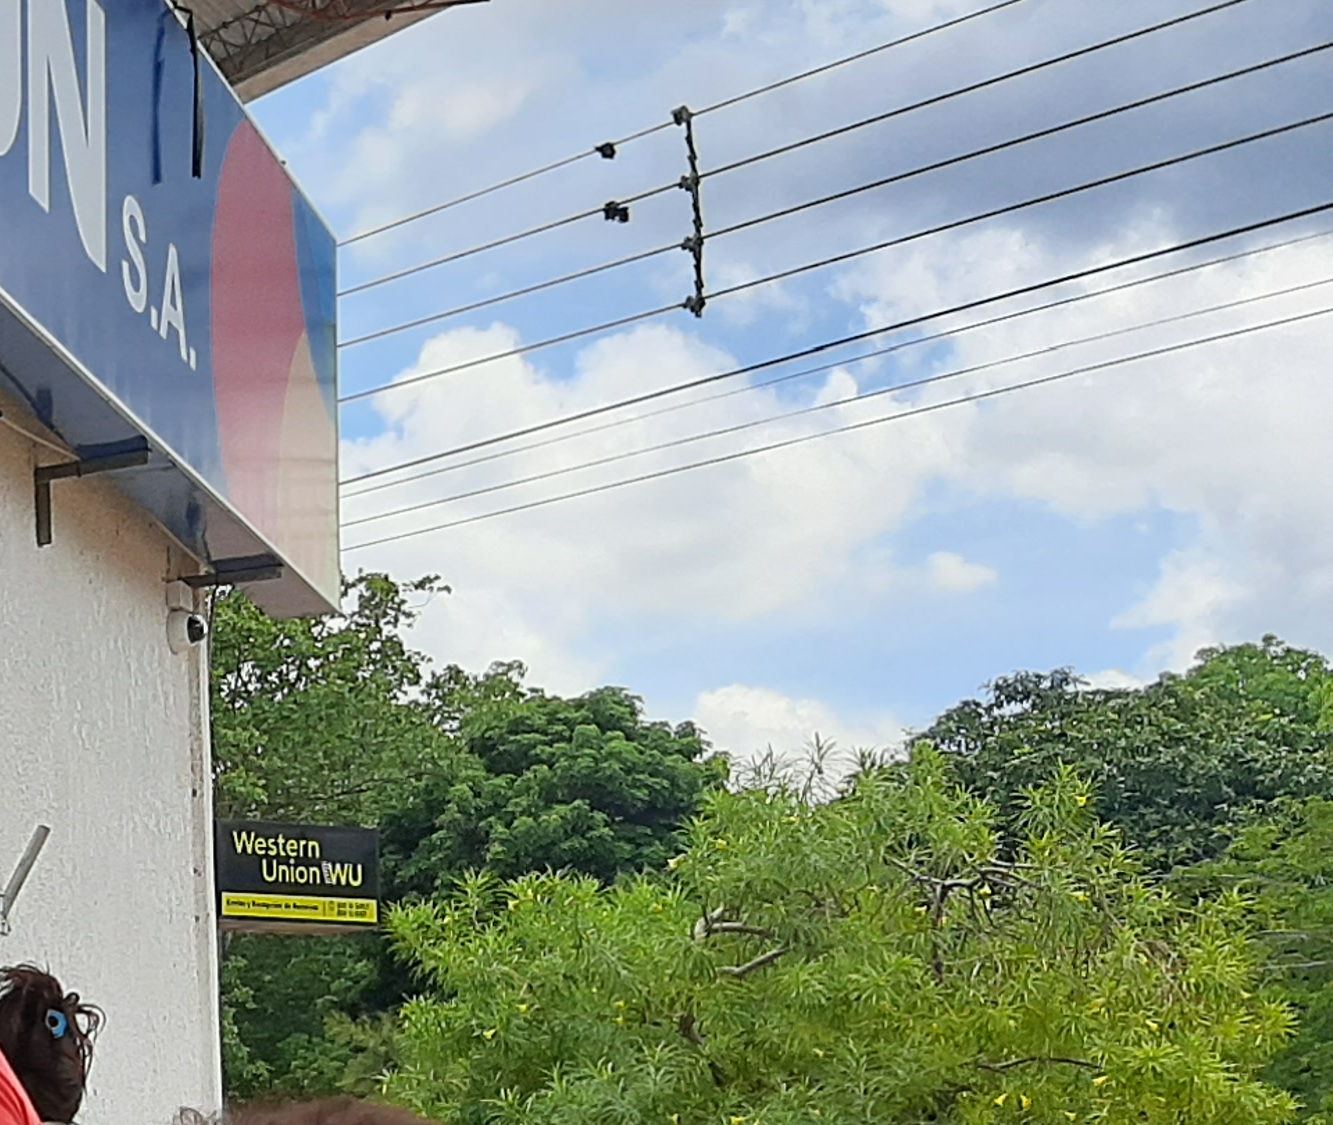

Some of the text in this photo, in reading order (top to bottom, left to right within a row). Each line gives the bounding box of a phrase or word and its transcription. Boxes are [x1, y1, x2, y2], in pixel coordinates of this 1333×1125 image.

[121, 195, 196, 372] S.A.
[233, 831, 321, 859] Western
[262, 859, 363, 887] Union WU
